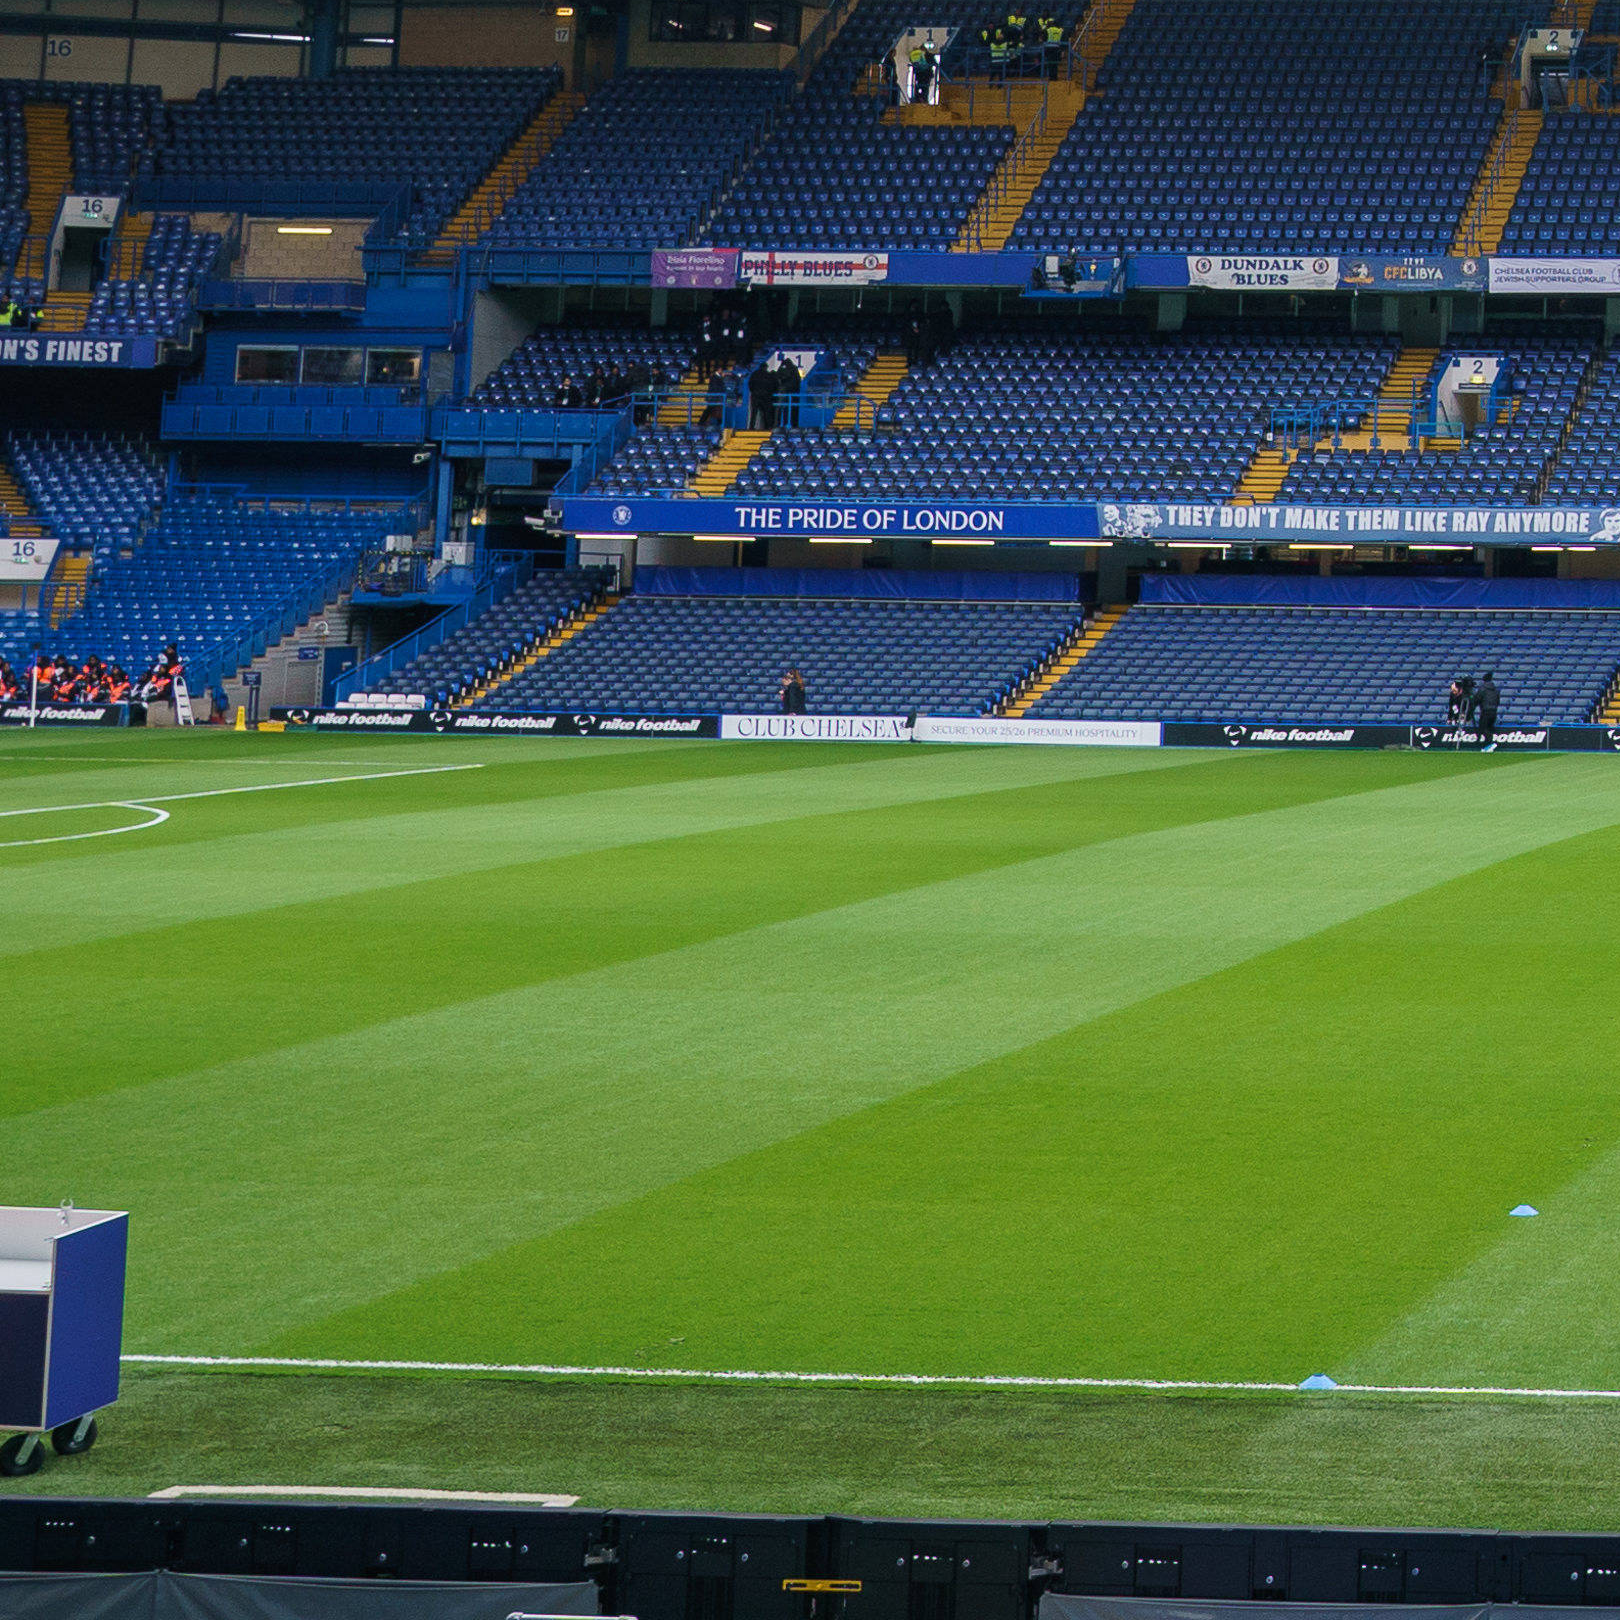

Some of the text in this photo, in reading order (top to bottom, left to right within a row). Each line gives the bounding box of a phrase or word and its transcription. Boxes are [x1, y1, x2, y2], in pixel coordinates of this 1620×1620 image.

[556, 30, 568, 41] 17
[926, 29, 933, 42] 1
[1549, 30, 1559, 43] 2
[48, 39, 71, 57] 16
[82, 199, 103, 213] 16
[743, 259, 797, 276] PHILLY
[802, 260, 854, 277] BLUES
[1220, 259, 1305, 271] DUNDALK
[1231, 273, 1289, 286] BLUES
[0, 339, 123, 363] N'S FINEST
[795, 354, 804, 369] 1
[1473, 360, 1483, 374] 2
[735, 507, 1004, 532] THE PRIDE OF LONDON
[1166, 506, 1590, 534] THEY DON'T MAKE THEM LIKE RAY ANYMORE
[12, 541, 35, 556] 16
[4, 706, 106, 720] nike football
[312, 712, 414, 725] nike football
[455, 715, 557, 728] nike football
[599, 717, 701, 731] nike football
[737, 718, 900, 738] CLUB CHELSEA
[931, 725, 967, 734] SECURE
[971, 725, 998, 735] YOUR
[1028, 728, 1073, 737] PREMIUM
[1075, 728, 1136, 738] HOSPITALITY
[1250, 728, 1355, 741] nike football
[1480, 730, 1546, 743] ootball
